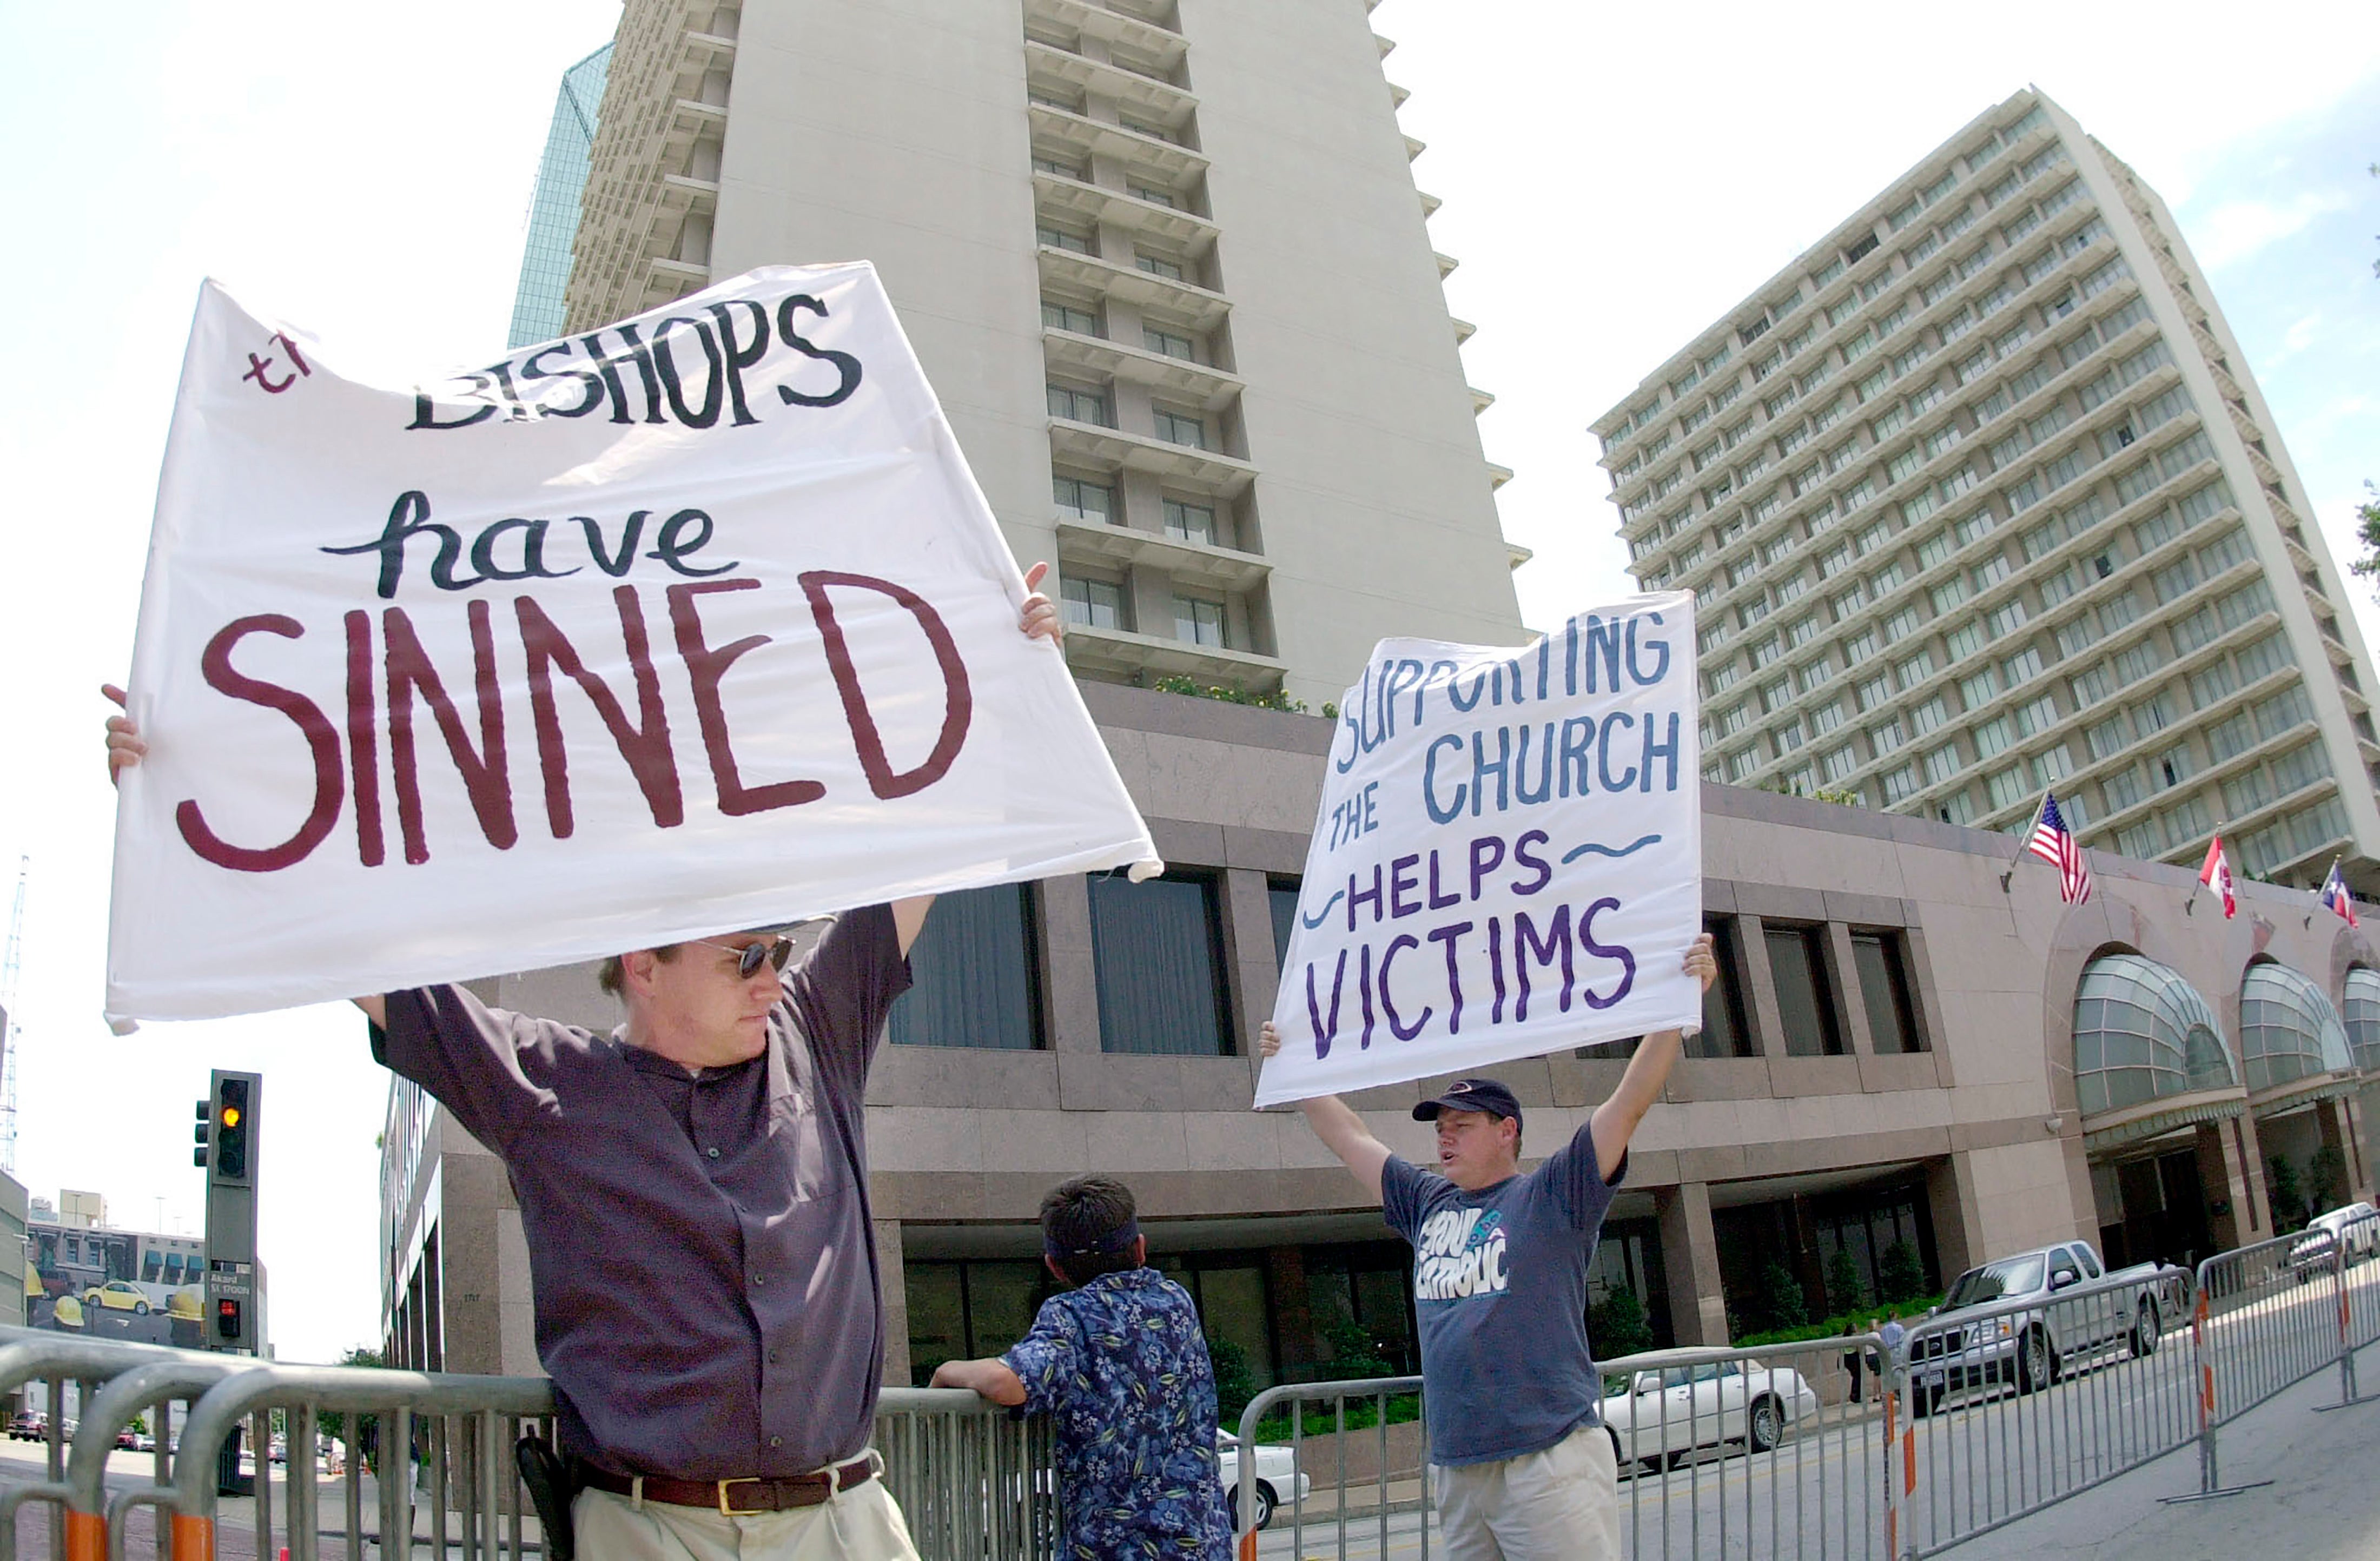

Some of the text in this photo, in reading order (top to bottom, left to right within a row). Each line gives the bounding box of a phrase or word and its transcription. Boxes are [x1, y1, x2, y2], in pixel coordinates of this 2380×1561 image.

[405, 294, 862, 430] BISHOPS
[319, 491, 738, 598] have
[176, 570, 972, 872] SINNED
[1330, 712, 1680, 851] THE CHURCH
[1348, 830, 1551, 932] HELPS
[1306, 897, 1636, 1060] VICTIMS
